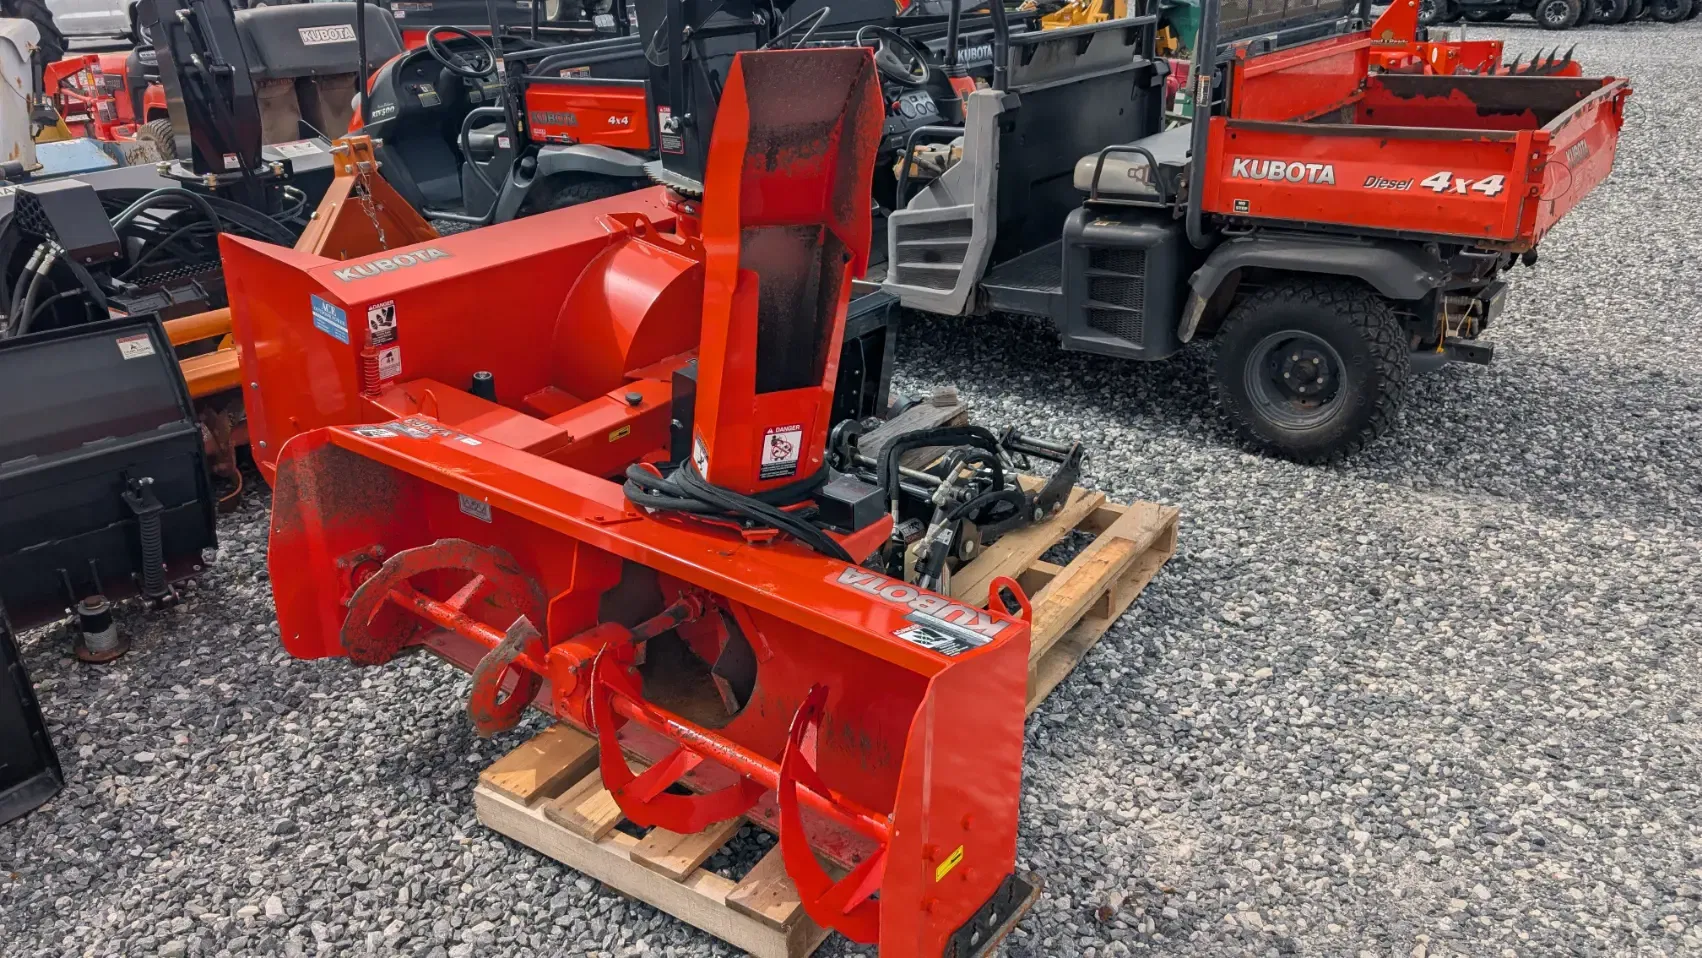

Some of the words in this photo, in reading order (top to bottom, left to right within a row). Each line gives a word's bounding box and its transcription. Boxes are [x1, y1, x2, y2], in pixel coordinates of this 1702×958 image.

[301, 27, 354, 42] KUBOTA
[957, 44, 993, 61] KUBOTA
[530, 111, 579, 127] KUBOTA
[607, 116, 629, 125] 4x4
[1231, 158, 1336, 185] KUBOTA
[1363, 175, 1415, 191] Diesel
[1420, 171, 1506, 197] 4x4
[333, 247, 450, 282] KUBOTA
[775, 424, 801, 433] DANGER
[837, 567, 1011, 638] KUBOTA
